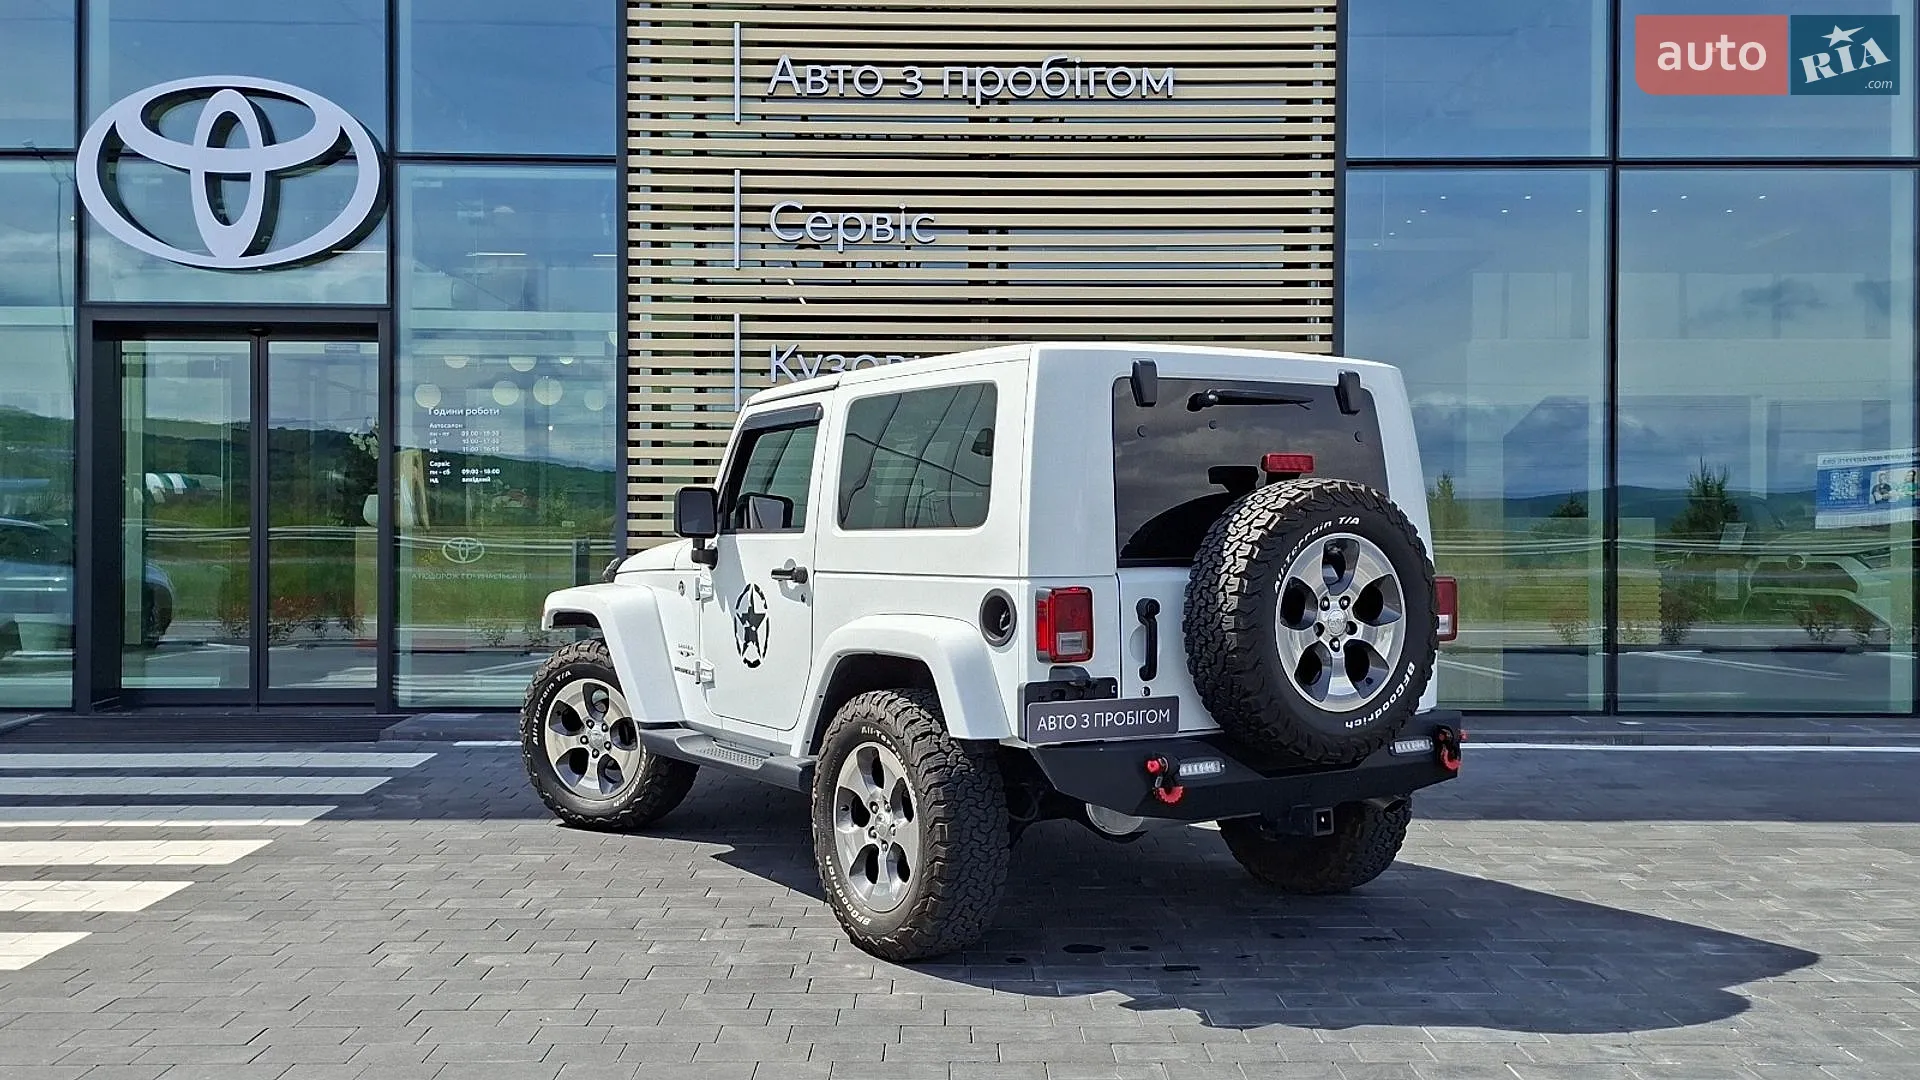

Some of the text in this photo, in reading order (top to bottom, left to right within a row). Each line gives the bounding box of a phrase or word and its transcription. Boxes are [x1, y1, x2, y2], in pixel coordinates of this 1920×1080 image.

[768, 54, 1174, 108] Авто з пробігом
[769, 200, 936, 253] Сервіс
[429, 407, 500, 417] Години роботи
[1338, 516, 1360, 525] T/A
[1345, 661, 1415, 729] BFGoodrich
[1037, 708, 1170, 731] АВТО З ПРОБІГОМ
